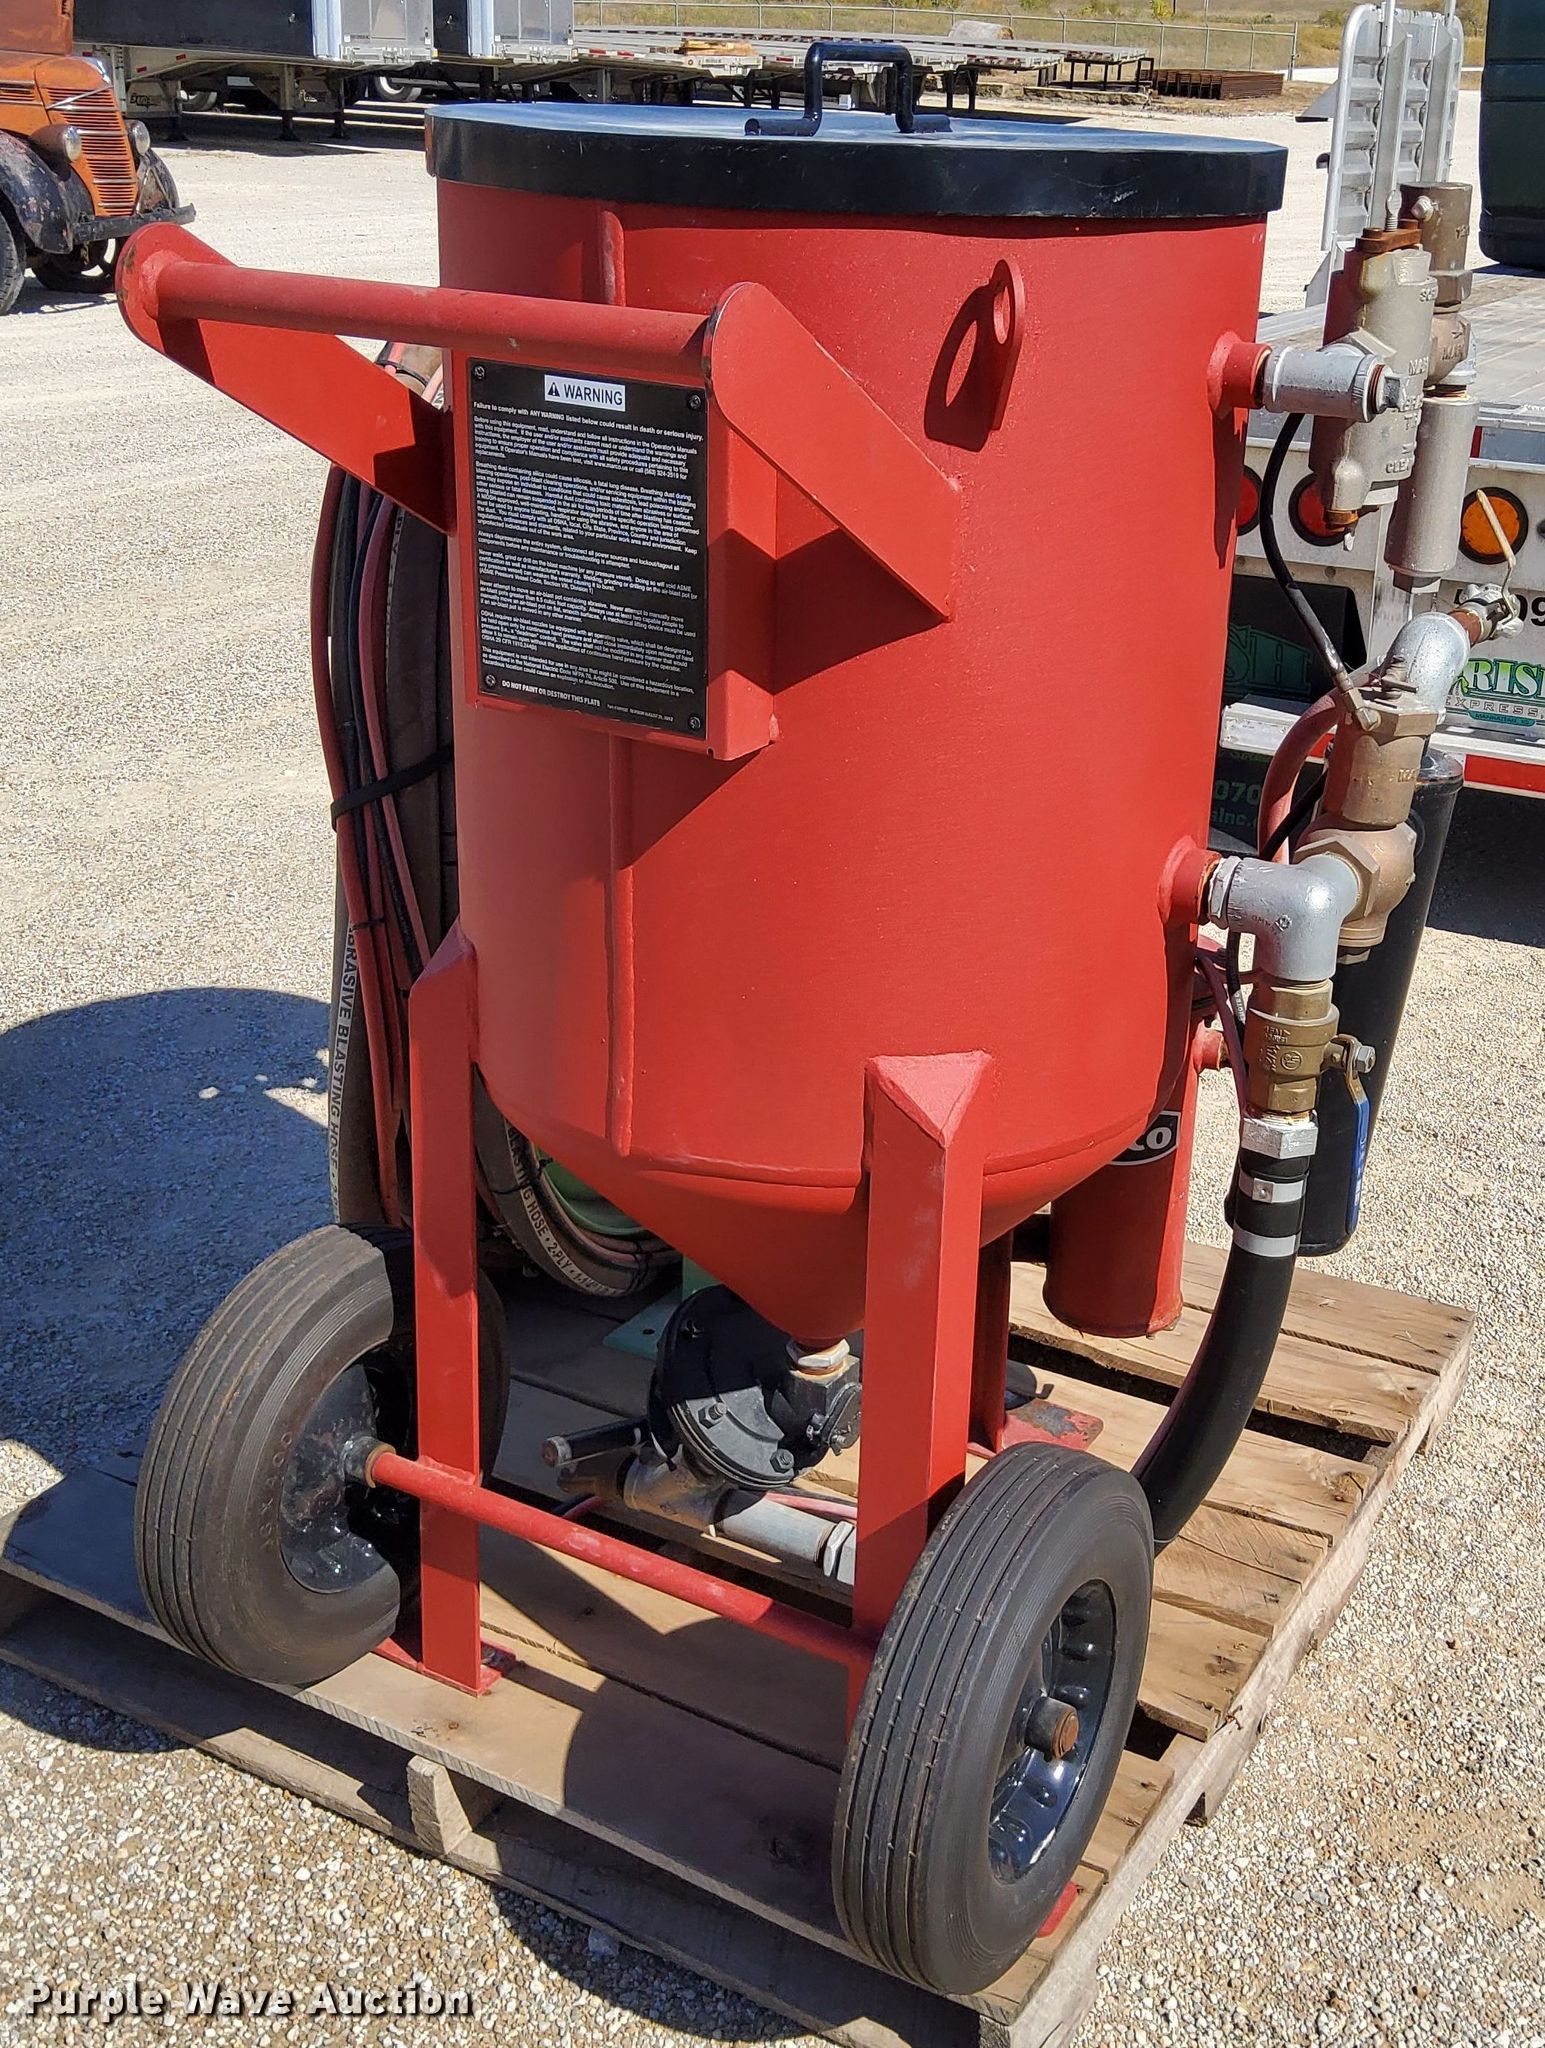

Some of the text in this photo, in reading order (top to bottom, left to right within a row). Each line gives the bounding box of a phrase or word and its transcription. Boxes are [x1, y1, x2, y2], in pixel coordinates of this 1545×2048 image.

[564, 383, 623, 406] WARNING
[501, 679, 600, 707] DO NOT PAINT OR DESTROY THIS PLATE
[1467, 657, 1545, 696] RIS
[331, 1022, 350, 1118] BLASTING
[329, 1122, 341, 1172] HOSE
[526, 1199, 548, 1236] HOSE
